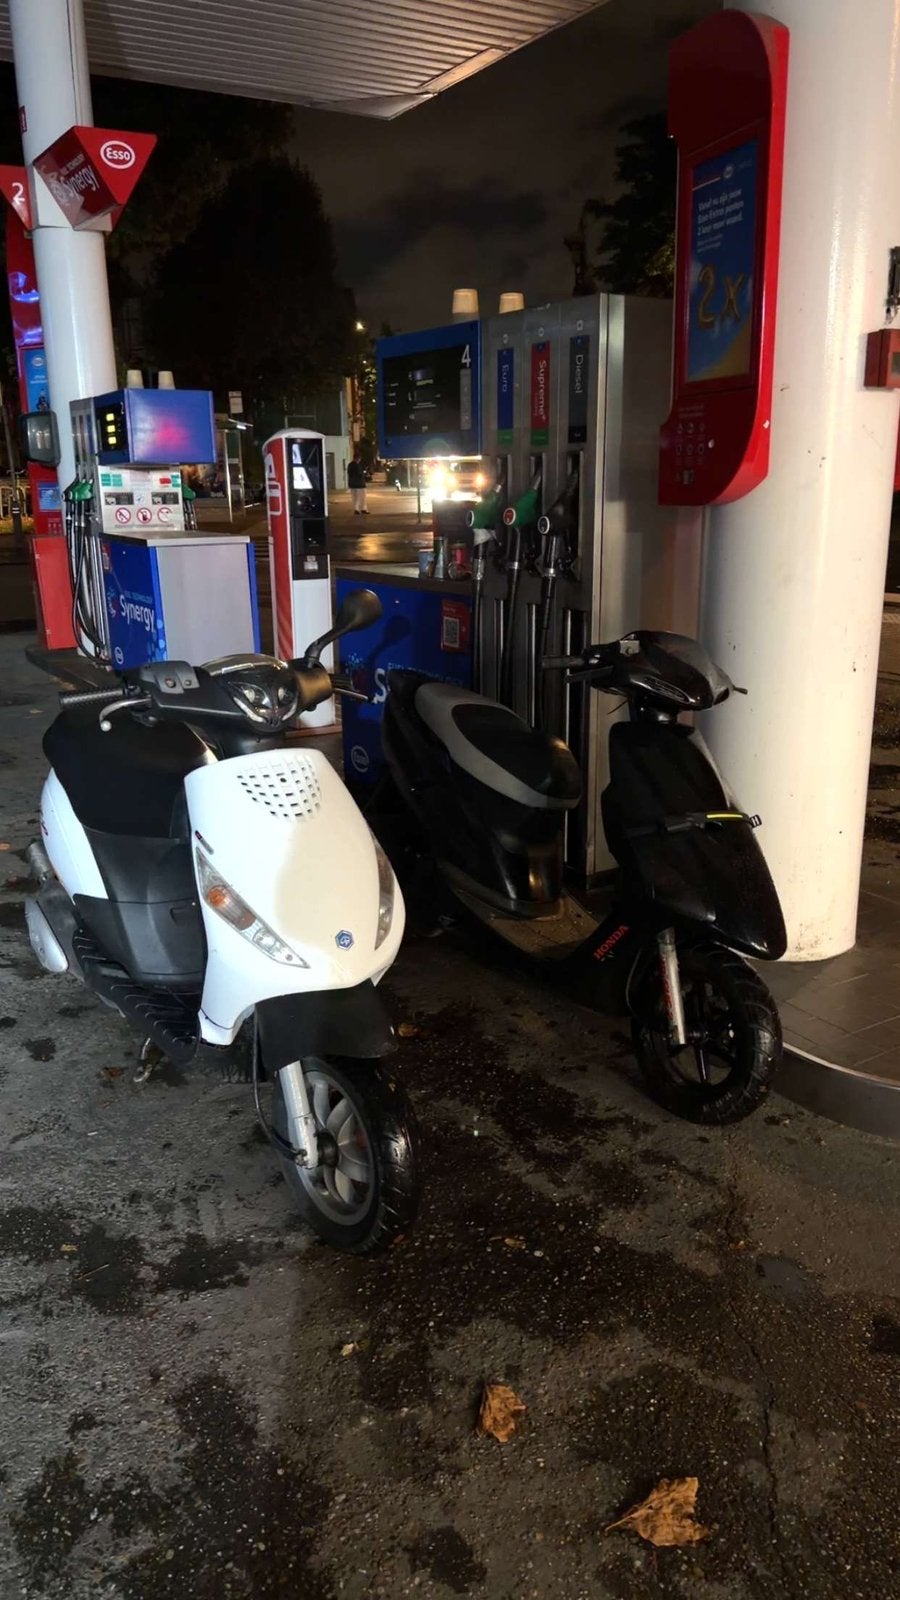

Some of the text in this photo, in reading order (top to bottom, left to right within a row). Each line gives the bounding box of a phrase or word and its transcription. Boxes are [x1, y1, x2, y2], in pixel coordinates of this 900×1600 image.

[106, 148, 130, 161] Esso
[11, 182, 25, 203] 2
[461, 343, 471, 368] 4
[501, 364, 510, 392] Euro
[574, 354, 584, 394] Diesel
[119, 594, 155, 633] Synergy
[593, 924, 630, 960] HONDA
